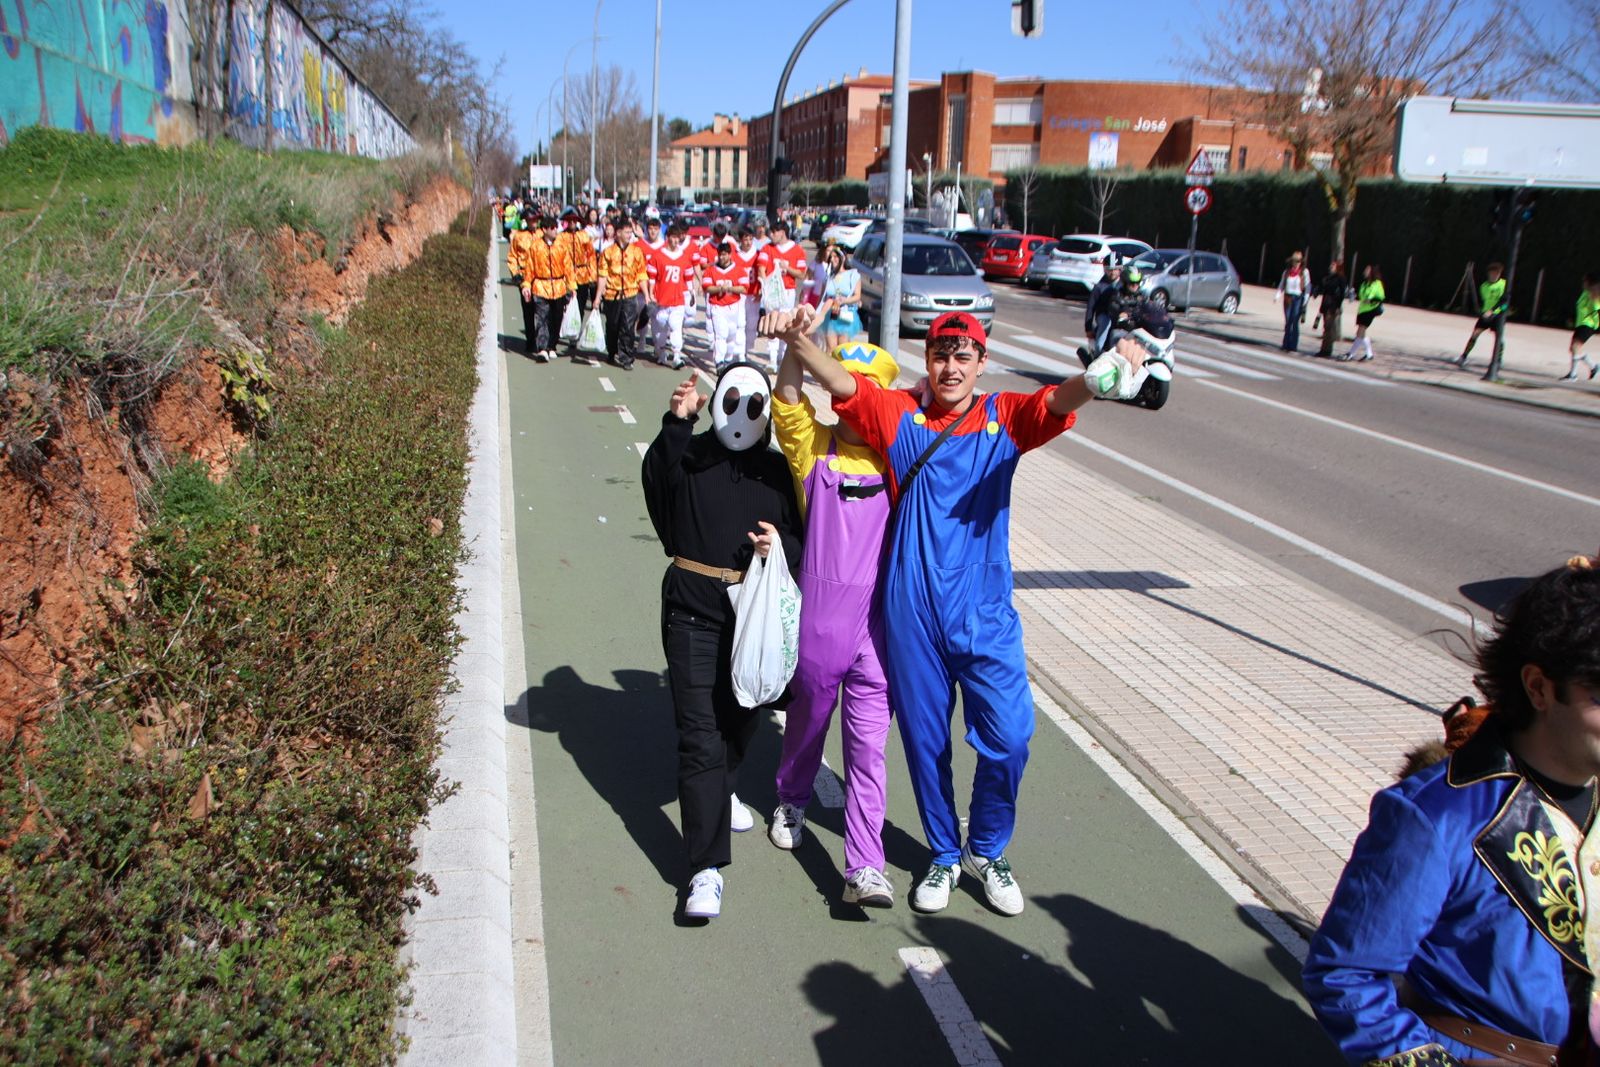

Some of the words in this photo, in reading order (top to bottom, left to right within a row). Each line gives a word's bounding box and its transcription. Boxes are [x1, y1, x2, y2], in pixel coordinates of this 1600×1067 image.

[1104, 115, 1131, 130] San
[1133, 116, 1167, 132] José
[665, 265, 680, 282] 78
[840, 345, 878, 366] W
